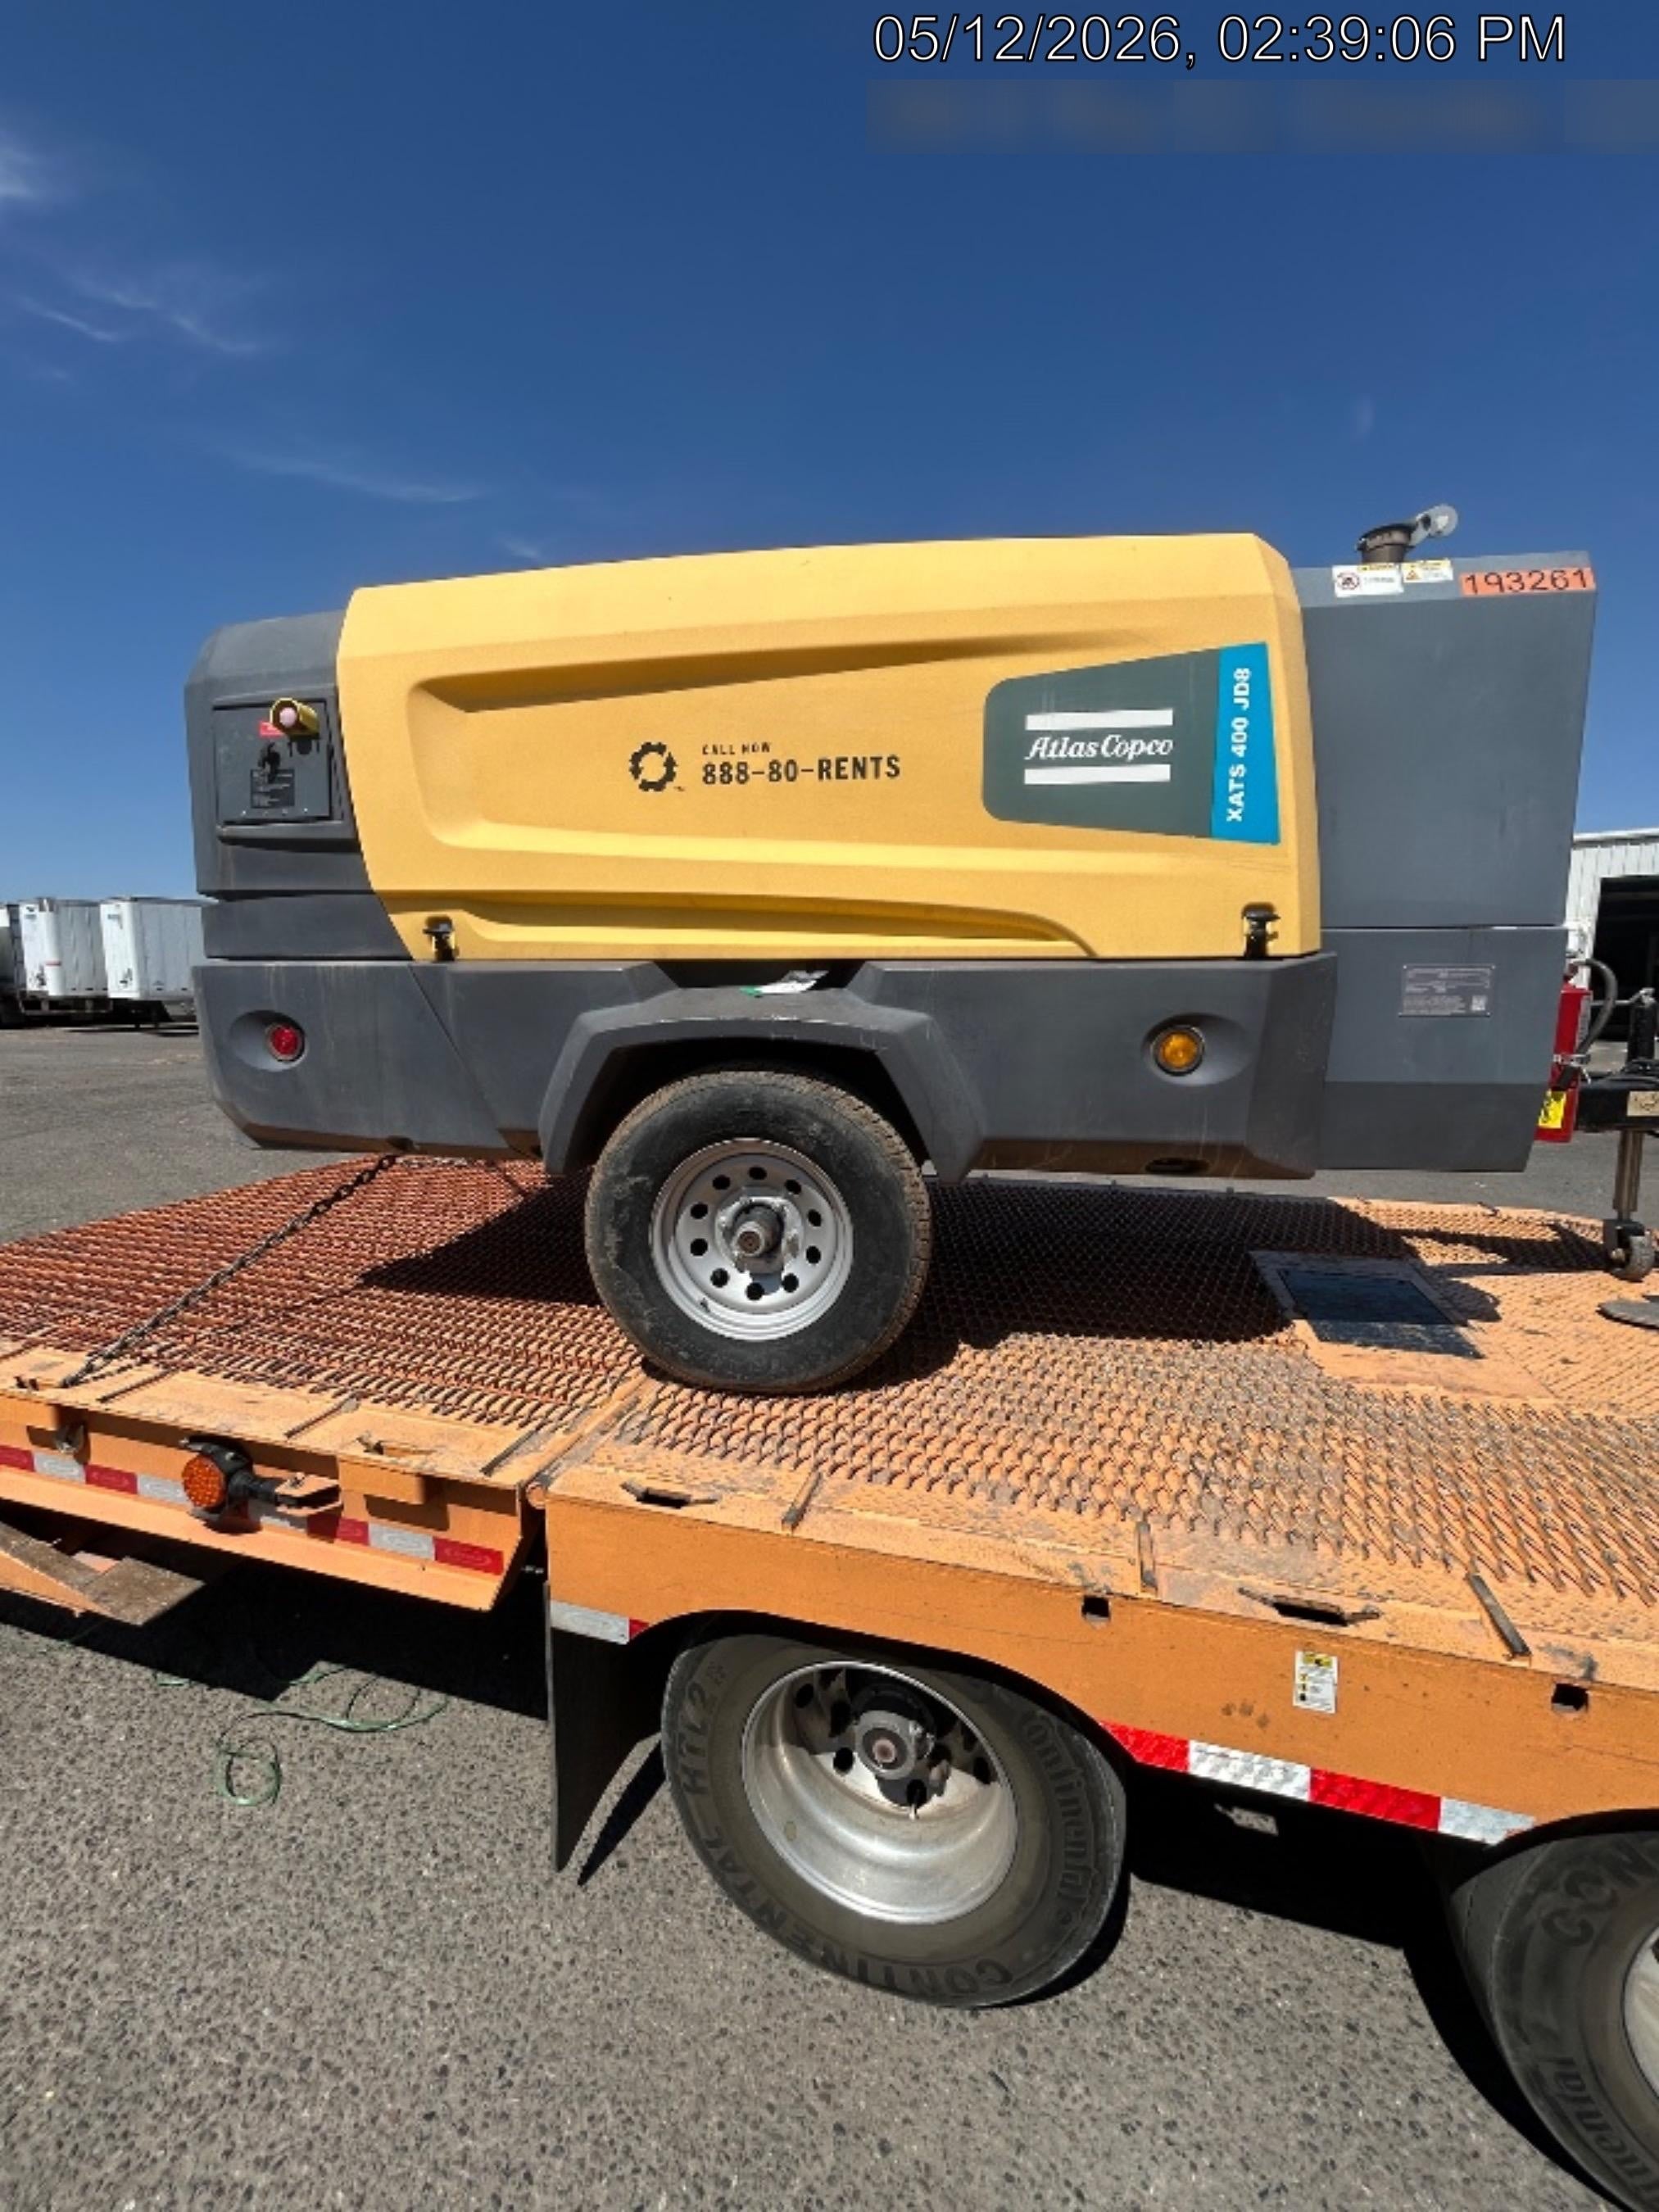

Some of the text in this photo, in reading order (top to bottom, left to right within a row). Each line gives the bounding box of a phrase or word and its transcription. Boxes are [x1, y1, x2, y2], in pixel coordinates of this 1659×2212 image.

[1464, 569, 1588, 594] 193261
[702, 741, 770, 755] CALL NOW
[1024, 733, 1174, 761] Atlas Copco
[1226, 666, 1253, 823] XATS 400 JD8
[702, 754, 901, 785] 888-80-RENTS
